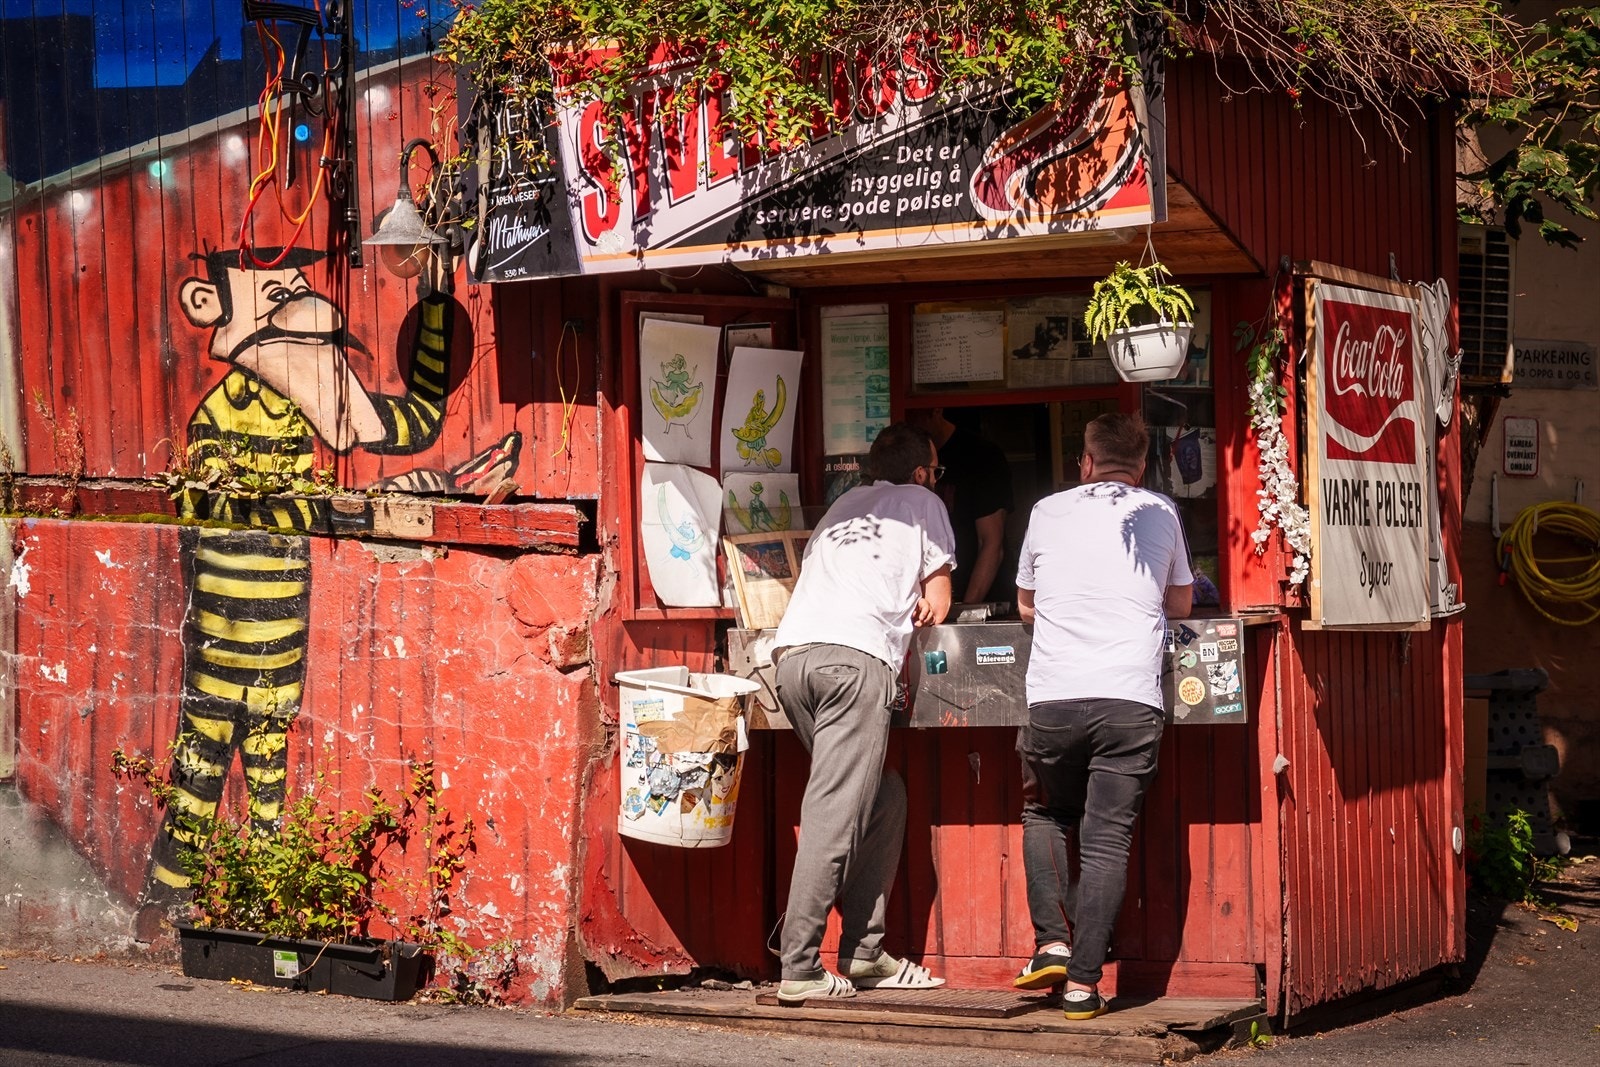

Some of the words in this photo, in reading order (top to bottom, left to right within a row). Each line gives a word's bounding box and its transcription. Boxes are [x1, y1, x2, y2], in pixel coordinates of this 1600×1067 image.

[896, 145, 933, 165] Det
[938, 143, 961, 162] er
[851, 165, 942, 196] hyggelig
[948, 163, 962, 184] å
[755, 203, 833, 225] servere
[838, 195, 890, 222] gode
[896, 190, 964, 217] pølser
[504, 268, 518, 278] 330
[517, 266, 528, 276] ML
[1333, 320, 1408, 400] Coca-Cola
[1515, 348, 1591, 366] PARKERING
[1584, 371, 1591, 380] C
[1323, 477, 1371, 526] VARME
[1376, 478, 1423, 527] PØLSER
[1360, 551, 1394, 598] Syver
